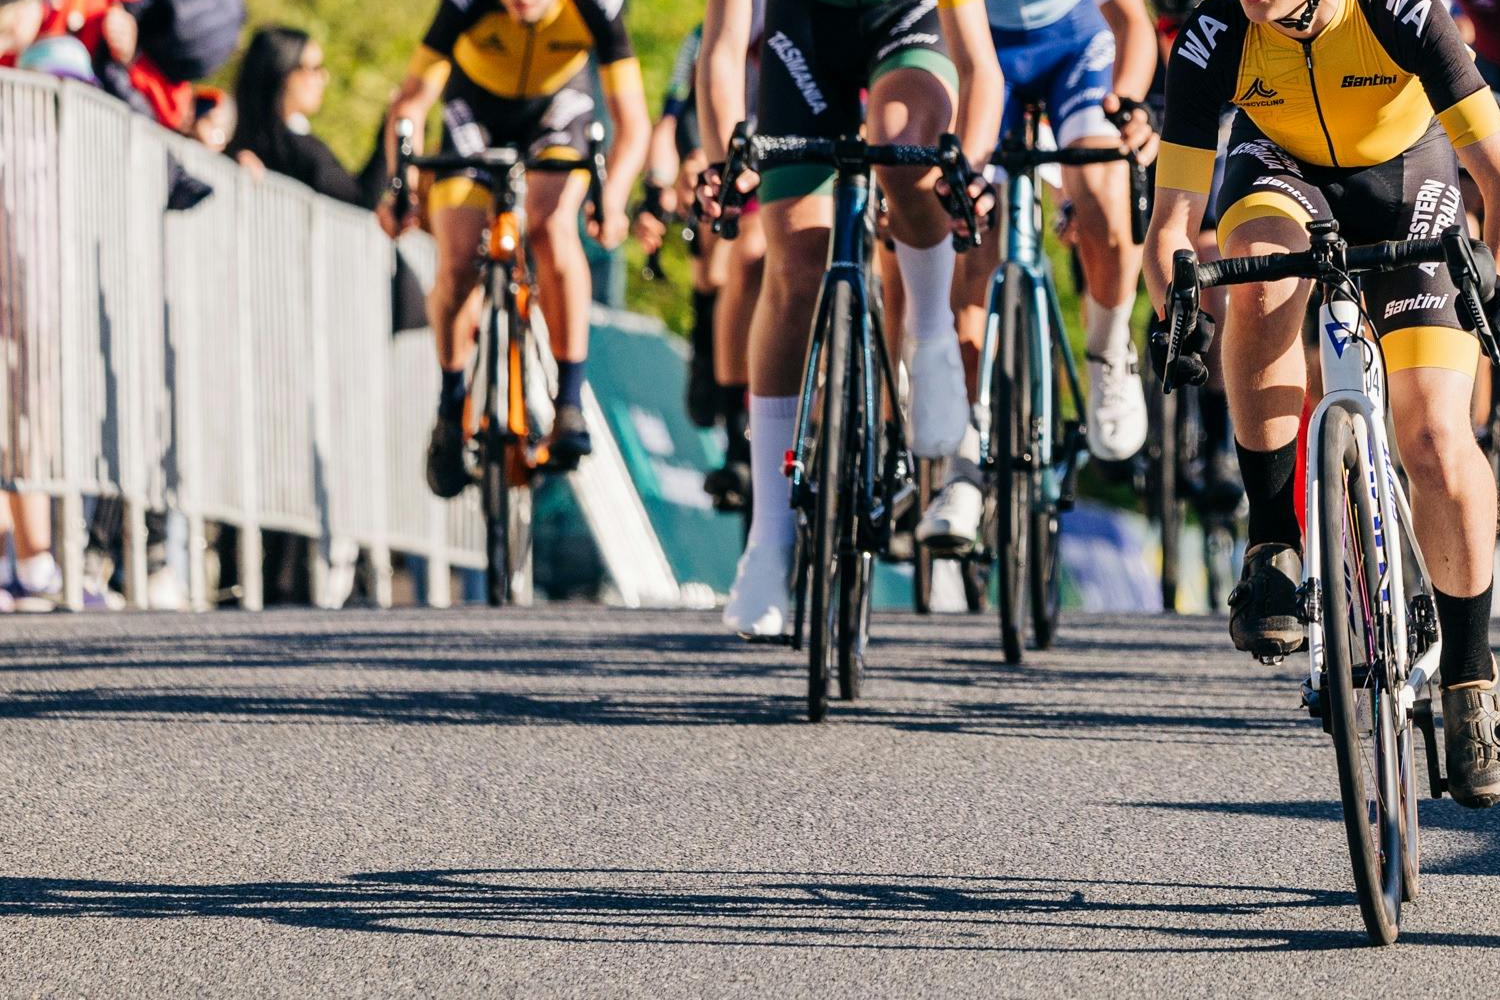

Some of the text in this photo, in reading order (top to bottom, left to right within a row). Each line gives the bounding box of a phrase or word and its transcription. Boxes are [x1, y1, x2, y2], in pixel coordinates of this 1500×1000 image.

[1177, 14, 1228, 70] WA
[767, 30, 828, 115] TASMANIA
[1341, 74, 1397, 88] Santini
[1384, 293, 1449, 319] Santini
